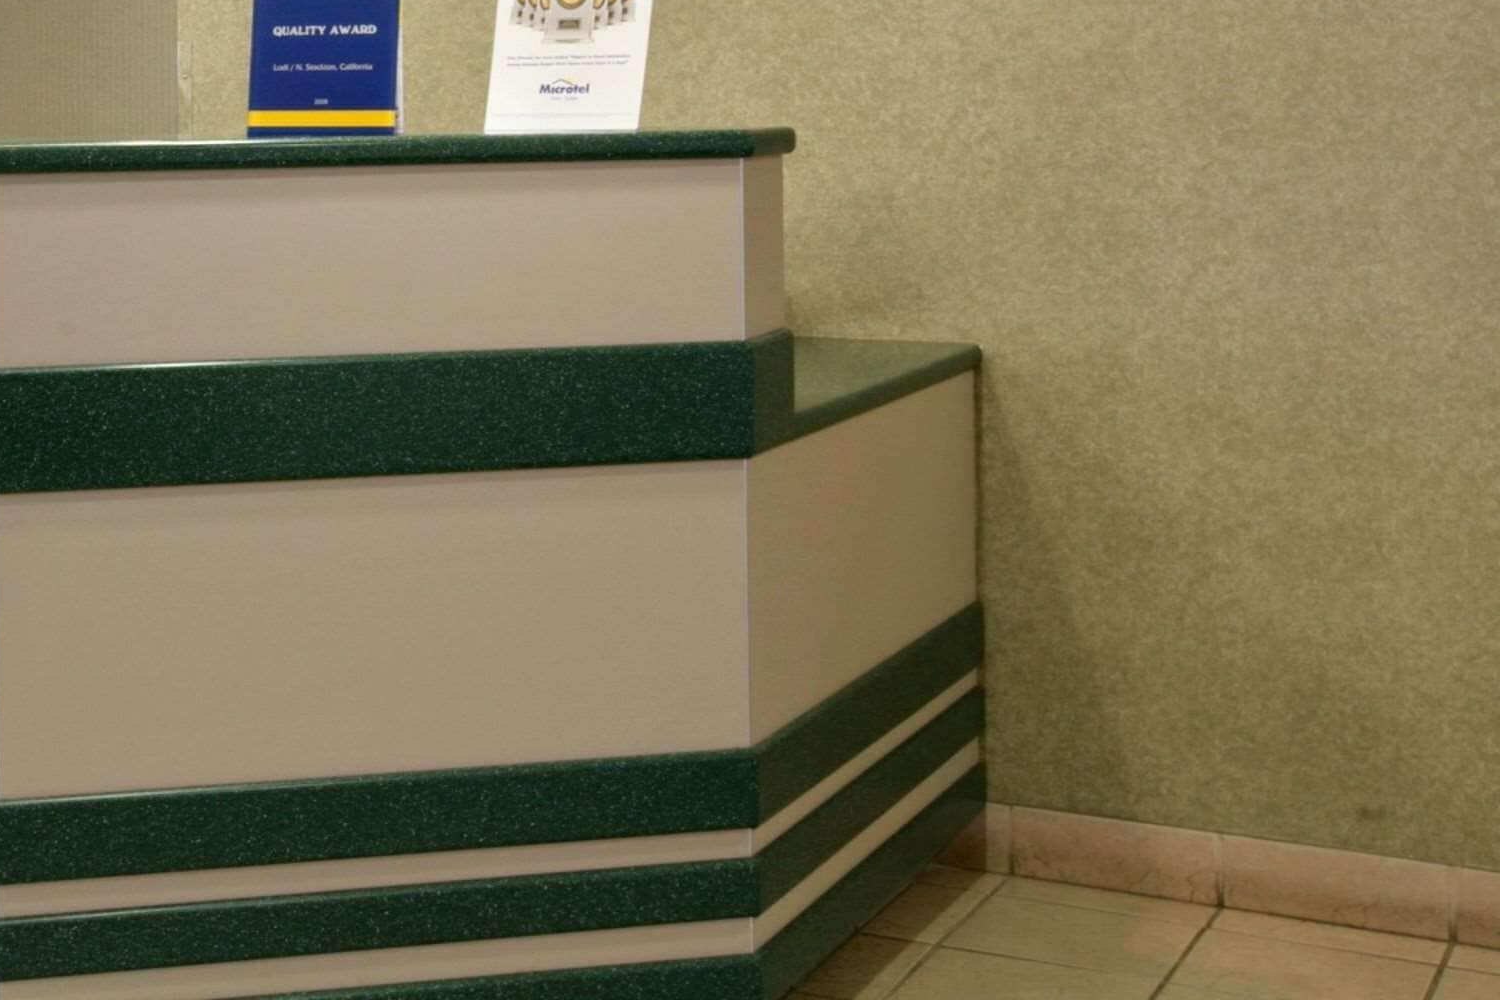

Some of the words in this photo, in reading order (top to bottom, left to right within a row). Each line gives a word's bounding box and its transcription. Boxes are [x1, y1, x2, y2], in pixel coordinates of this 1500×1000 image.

[273, 25, 326, 37] QUALITY
[329, 24, 378, 35] AWARD
[339, 62, 374, 71] California
[539, 84, 590, 94] Microtel
